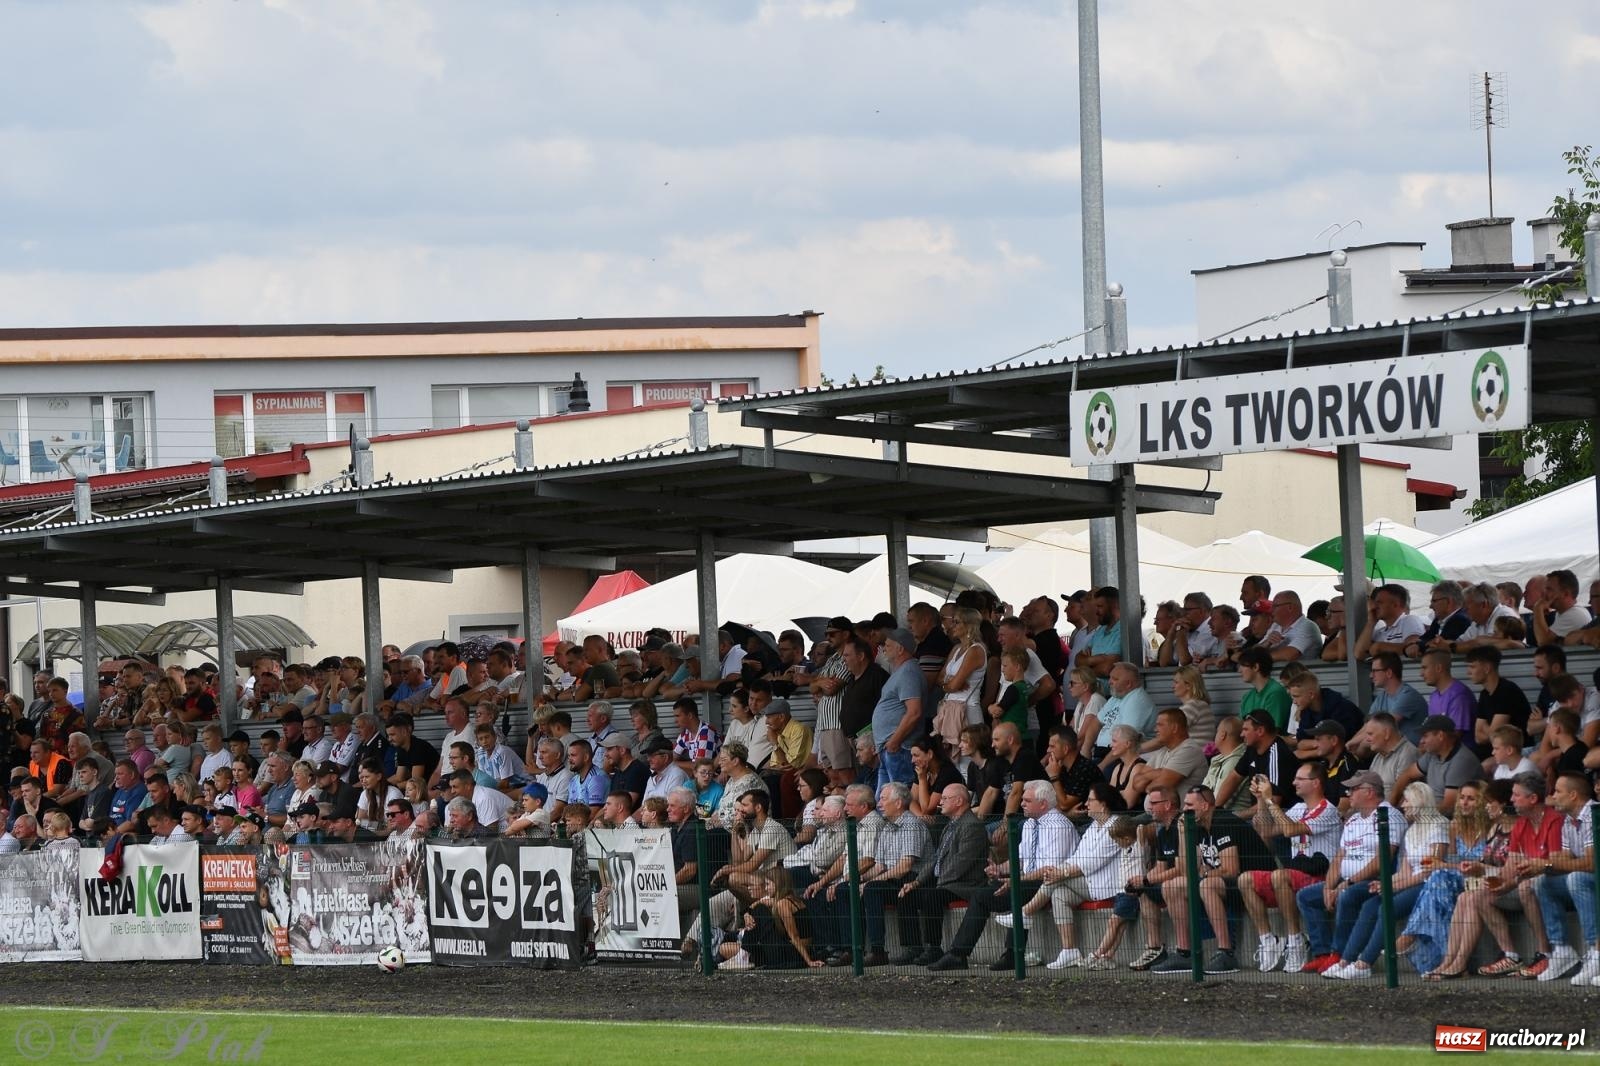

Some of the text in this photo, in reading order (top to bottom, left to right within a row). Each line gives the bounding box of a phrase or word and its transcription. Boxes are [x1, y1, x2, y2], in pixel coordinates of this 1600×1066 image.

[255, 396, 324, 410] SYPIALNIANE
[645, 387, 709, 401] PRODUCENT
[1139, 364, 1444, 453] LKS TWORKÓW
[203, 860, 254, 878] KREWETKA
[84, 865, 193, 917] KERAKOLL
[637, 872, 668, 891] OKNA
[110, 922, 123, 936] The
[434, 938, 487, 957] WWW.KEEZA.PL
[511, 938, 534, 958] ODZIEŻ
